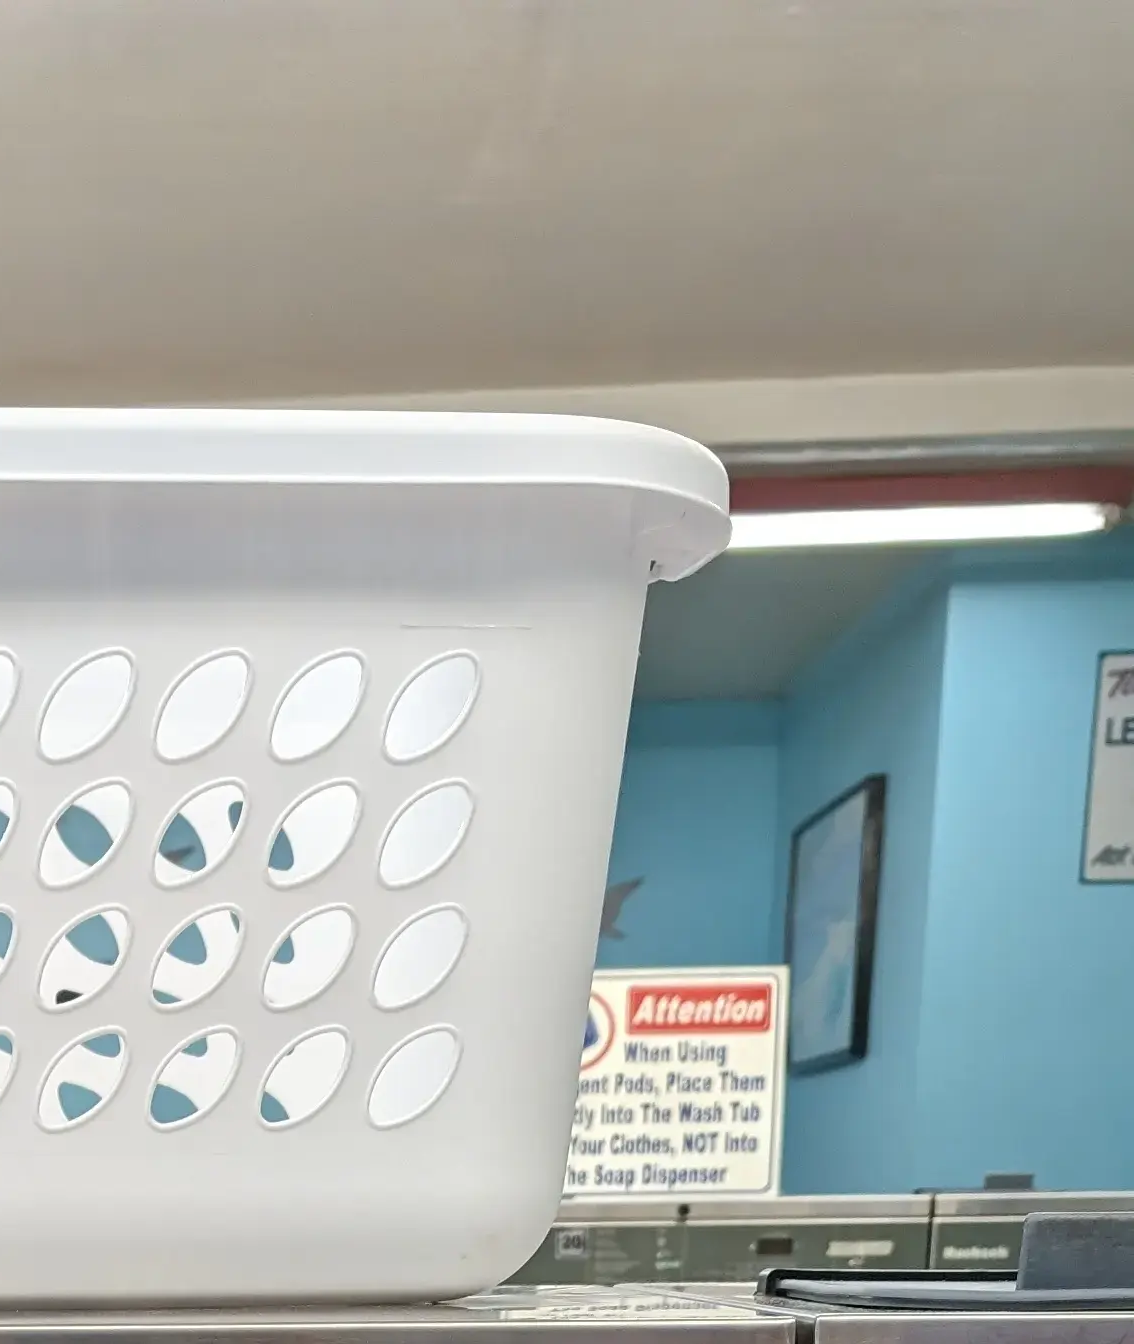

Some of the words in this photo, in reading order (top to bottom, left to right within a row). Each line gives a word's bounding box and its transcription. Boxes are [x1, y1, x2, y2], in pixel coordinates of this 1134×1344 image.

[632, 993, 765, 1025] Attention
[624, 1043, 670, 1063] When
[678, 1043, 727, 1066] Using
[614, 1073, 659, 1095] Pods,
[667, 1072, 712, 1093] Place
[720, 1071, 765, 1092] Them
[601, 1104, 633, 1123] Into
[641, 1103, 671, 1123] The
[679, 1103, 722, 1122] Wash
[730, 1102, 759, 1122] Tub
[610, 1134, 674, 1157] Clothes,
[683, 1133, 718, 1153] NOT
[725, 1133, 758, 1153] Into
[594, 1164, 634, 1187] Soap
[642, 1165, 727, 1187] Dispenser
